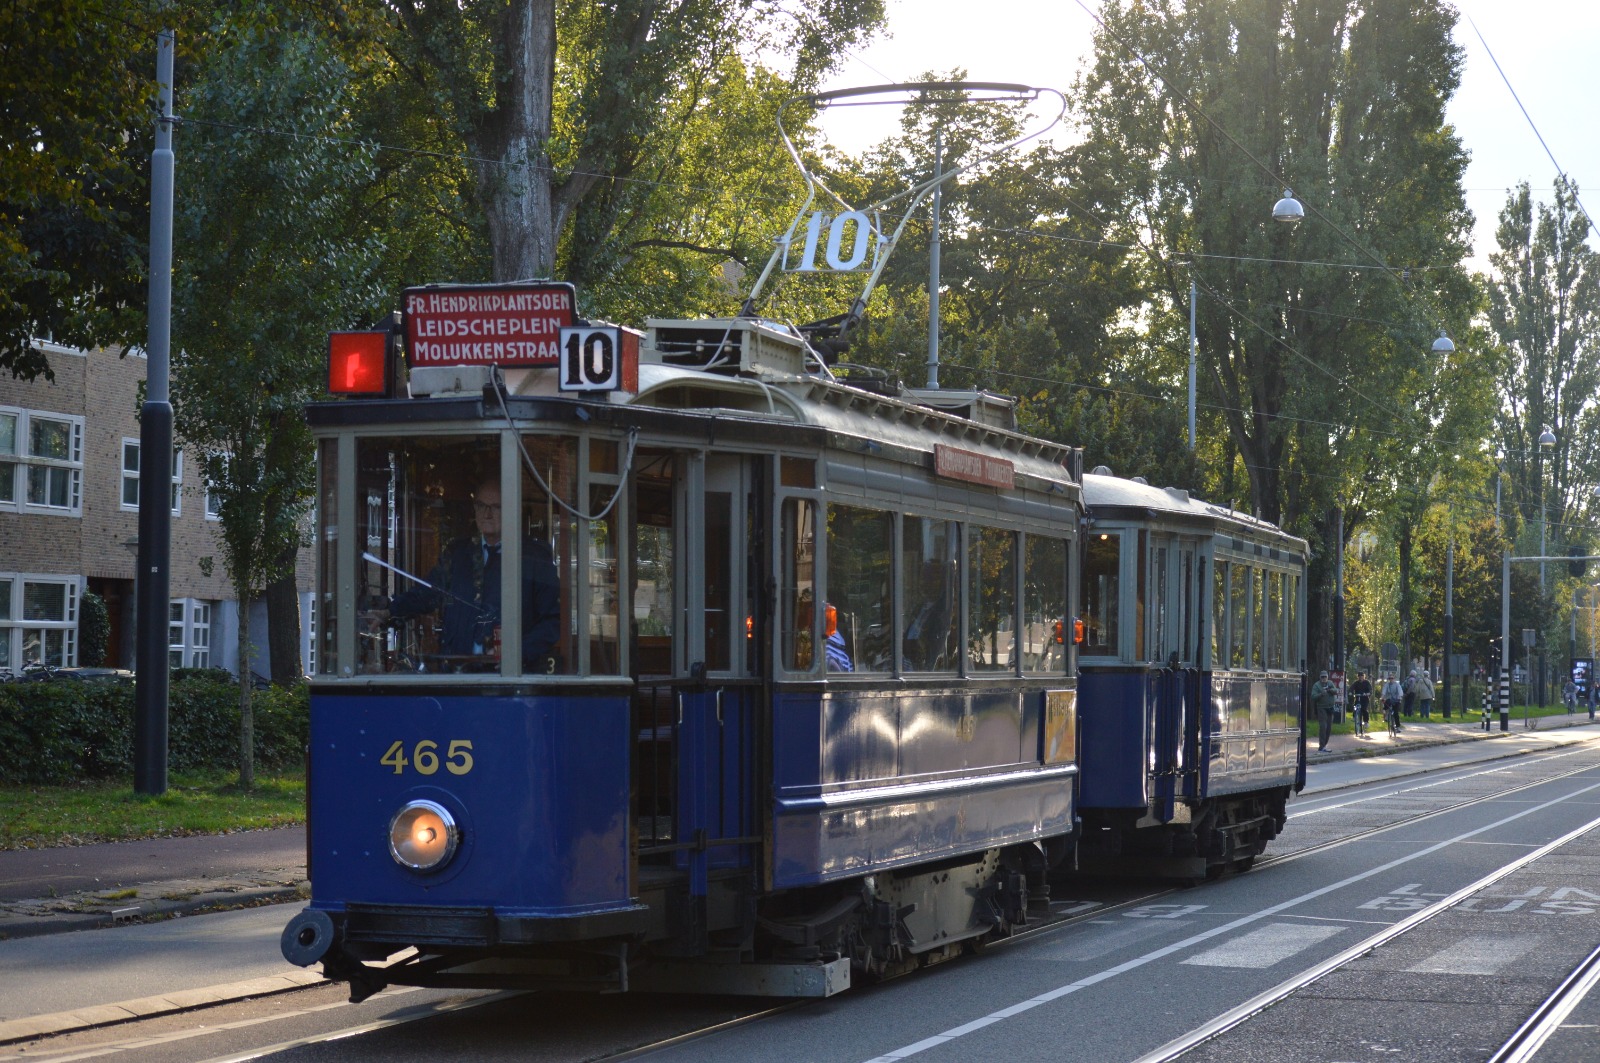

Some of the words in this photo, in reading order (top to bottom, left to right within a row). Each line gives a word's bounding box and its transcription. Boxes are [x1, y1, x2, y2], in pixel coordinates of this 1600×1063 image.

[795, 210, 871, 271] 10
[430, 293, 570, 313] HENDRIKPLANTSOEN
[416, 317, 561, 337] LEIDSCHEPLEIN
[564, 331, 613, 385] 10
[546, 657, 556, 674] 3
[379, 739, 474, 775] 465
[1355, 896, 1600, 915] BUS
